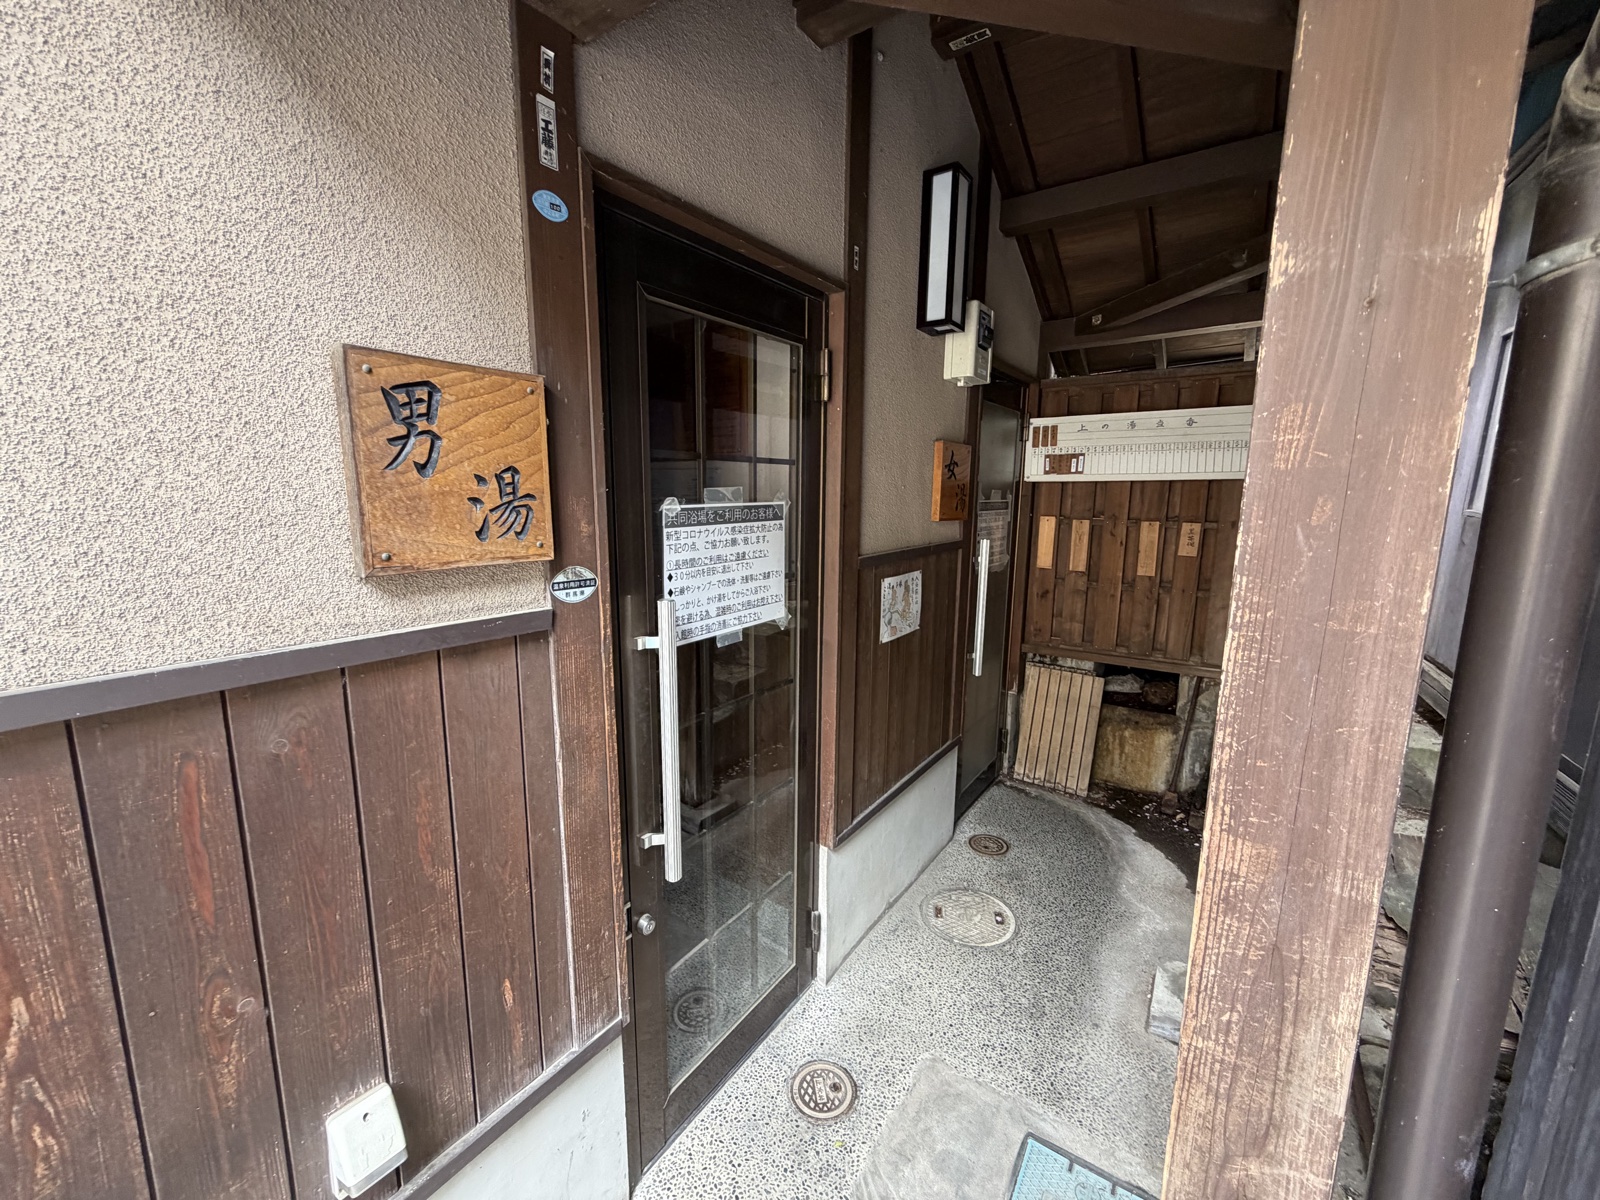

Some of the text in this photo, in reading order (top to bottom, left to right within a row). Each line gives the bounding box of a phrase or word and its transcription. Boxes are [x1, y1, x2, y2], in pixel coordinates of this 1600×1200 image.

[381, 380, 537, 542] 男湯
[944, 450, 966, 512] 女湯
[667, 507, 781, 525] 共同浴場をご利用のお客様へ
